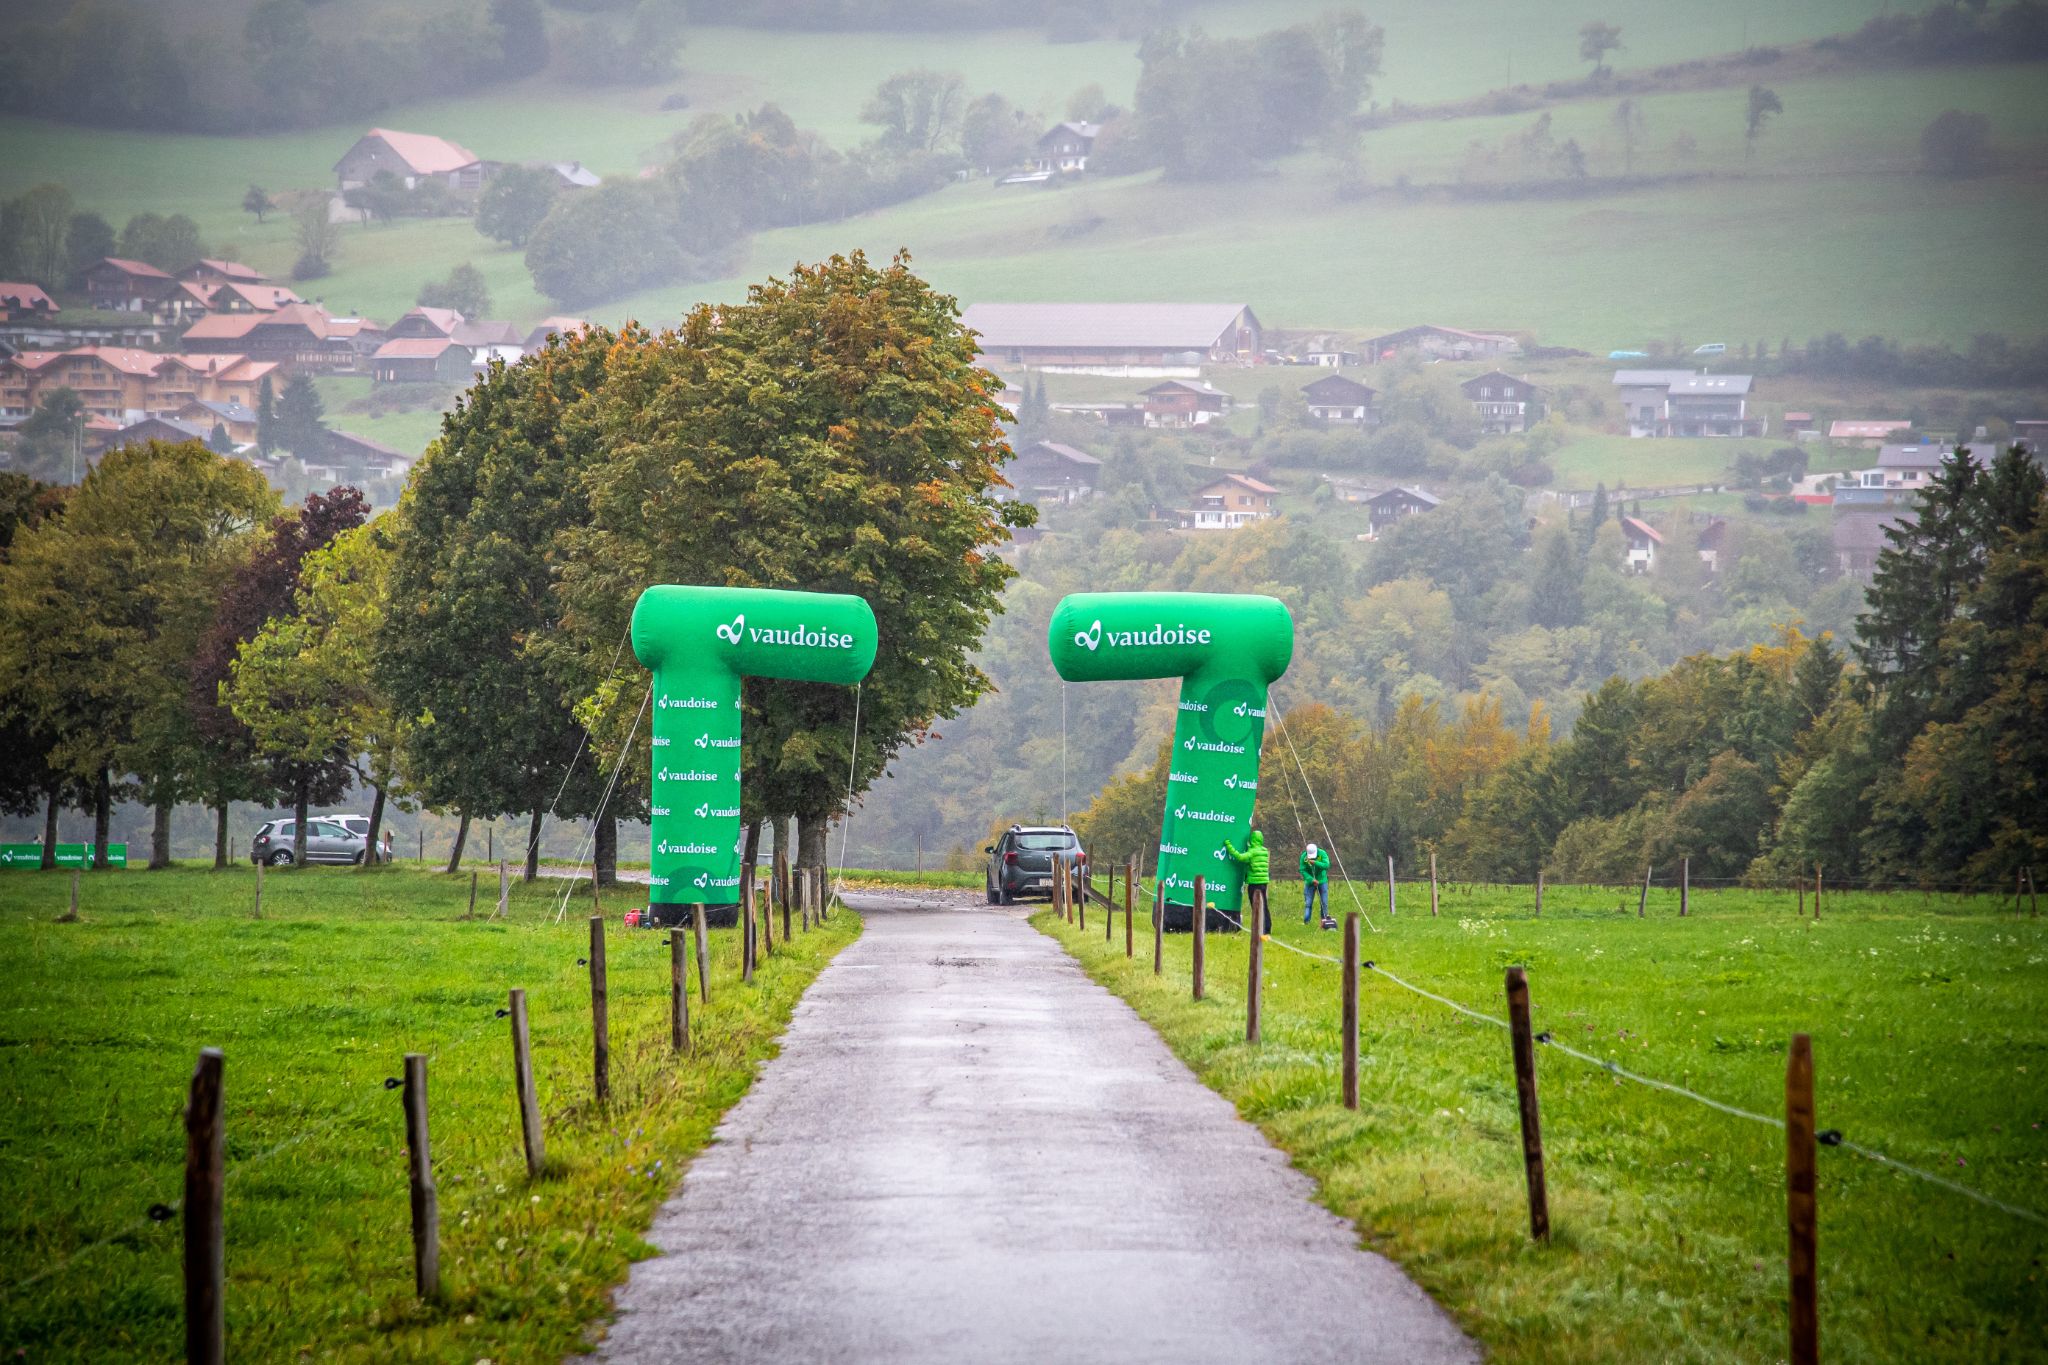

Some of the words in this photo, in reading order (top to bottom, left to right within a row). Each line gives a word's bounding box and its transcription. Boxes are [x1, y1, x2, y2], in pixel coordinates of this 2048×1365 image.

[749, 624, 853, 649] vaudoise
[1106, 624, 1211, 647] vaudoise
[668, 697, 718, 709] vaudoise
[1196, 741, 1245, 754] vaudoise
[668, 770, 718, 781] vaudoise
[1187, 810, 1235, 823] vaudoise
[668, 842, 718, 854] vaudoise
[1178, 880, 1227, 892] vauoise
